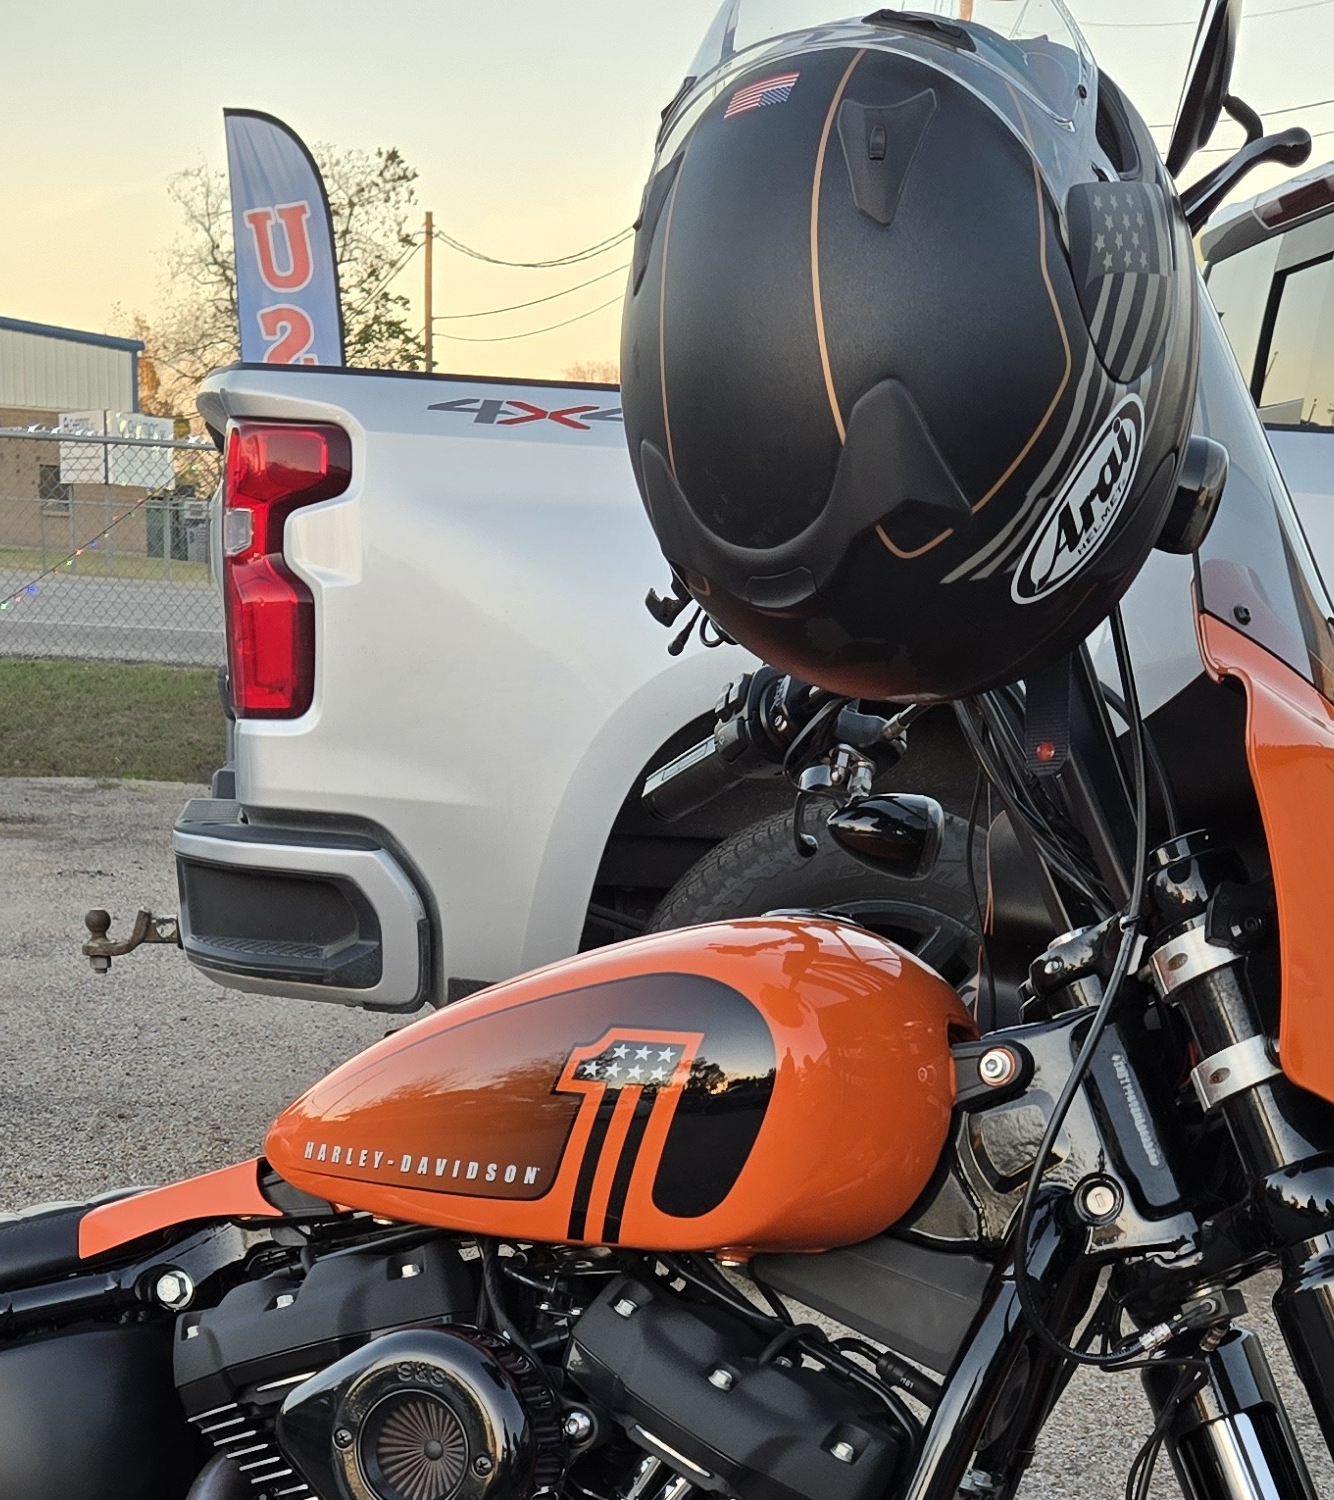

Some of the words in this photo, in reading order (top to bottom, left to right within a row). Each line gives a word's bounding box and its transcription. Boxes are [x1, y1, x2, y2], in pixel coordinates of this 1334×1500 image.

[1034, 415, 1134, 593] Arai
[303, 1141, 541, 1185] HARLEY-DAVIDSON
[397, 1361, 446, 1388] S&S
